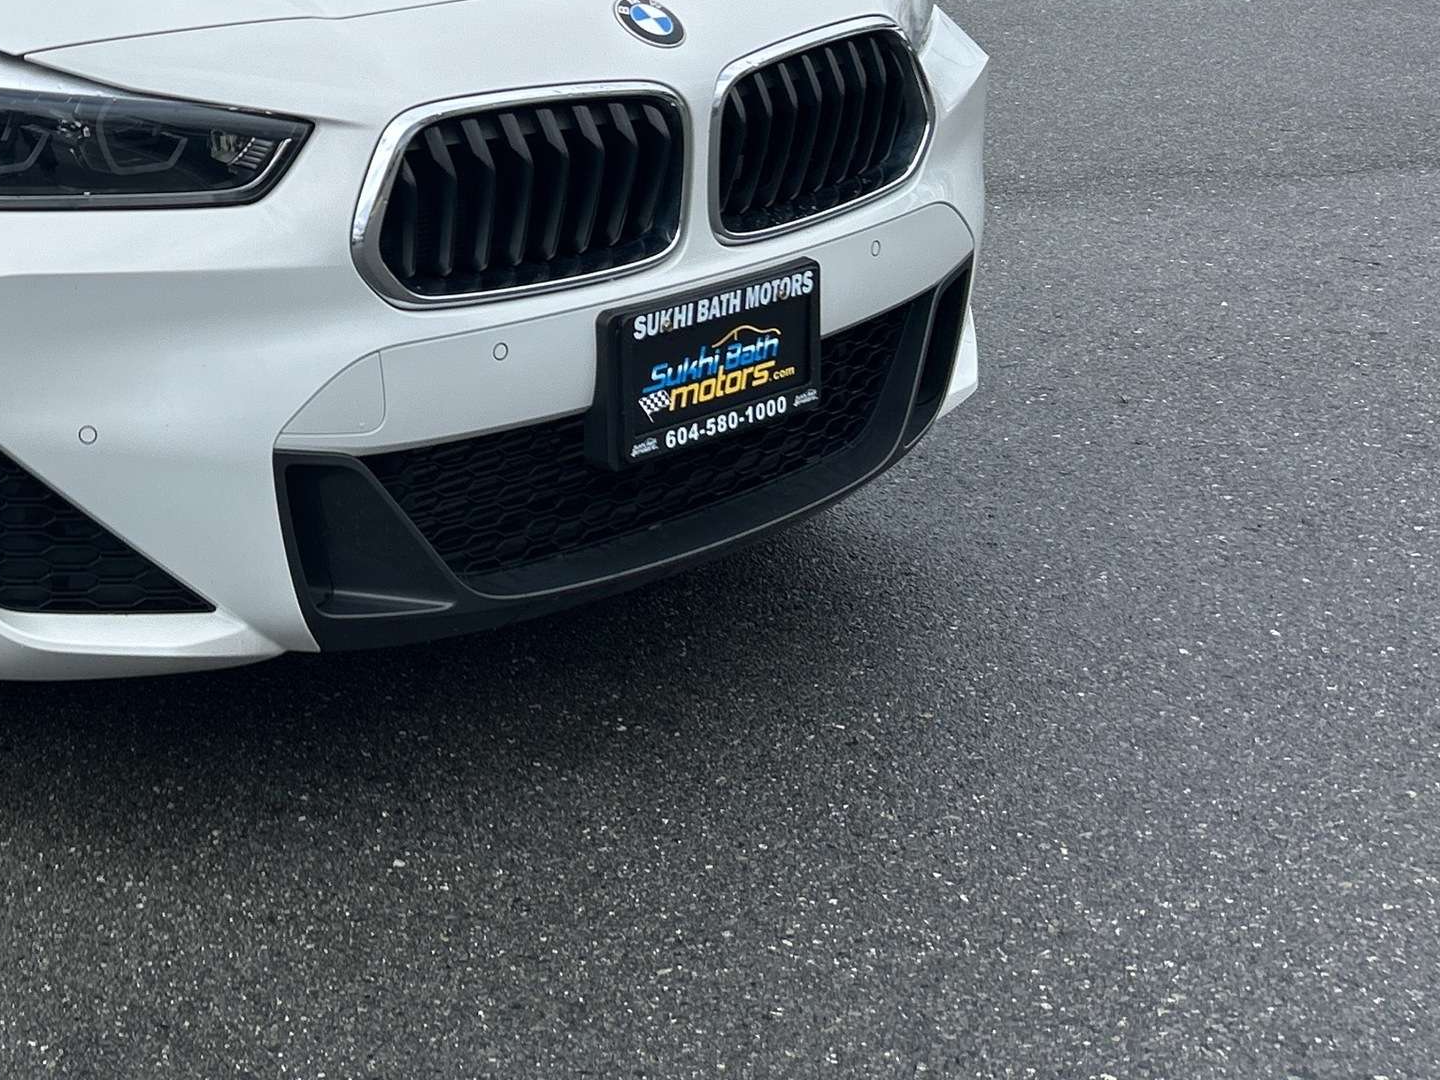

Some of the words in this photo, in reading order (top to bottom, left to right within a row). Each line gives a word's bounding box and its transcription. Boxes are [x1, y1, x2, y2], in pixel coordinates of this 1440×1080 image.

[633, 302, 694, 340] SUKHI
[696, 289, 742, 323] BATH
[745, 270, 814, 311] MOTORS
[642, 345, 721, 394] Sukhi
[725, 333, 781, 371] Bath
[665, 395, 788, 449] 604-580-1000
